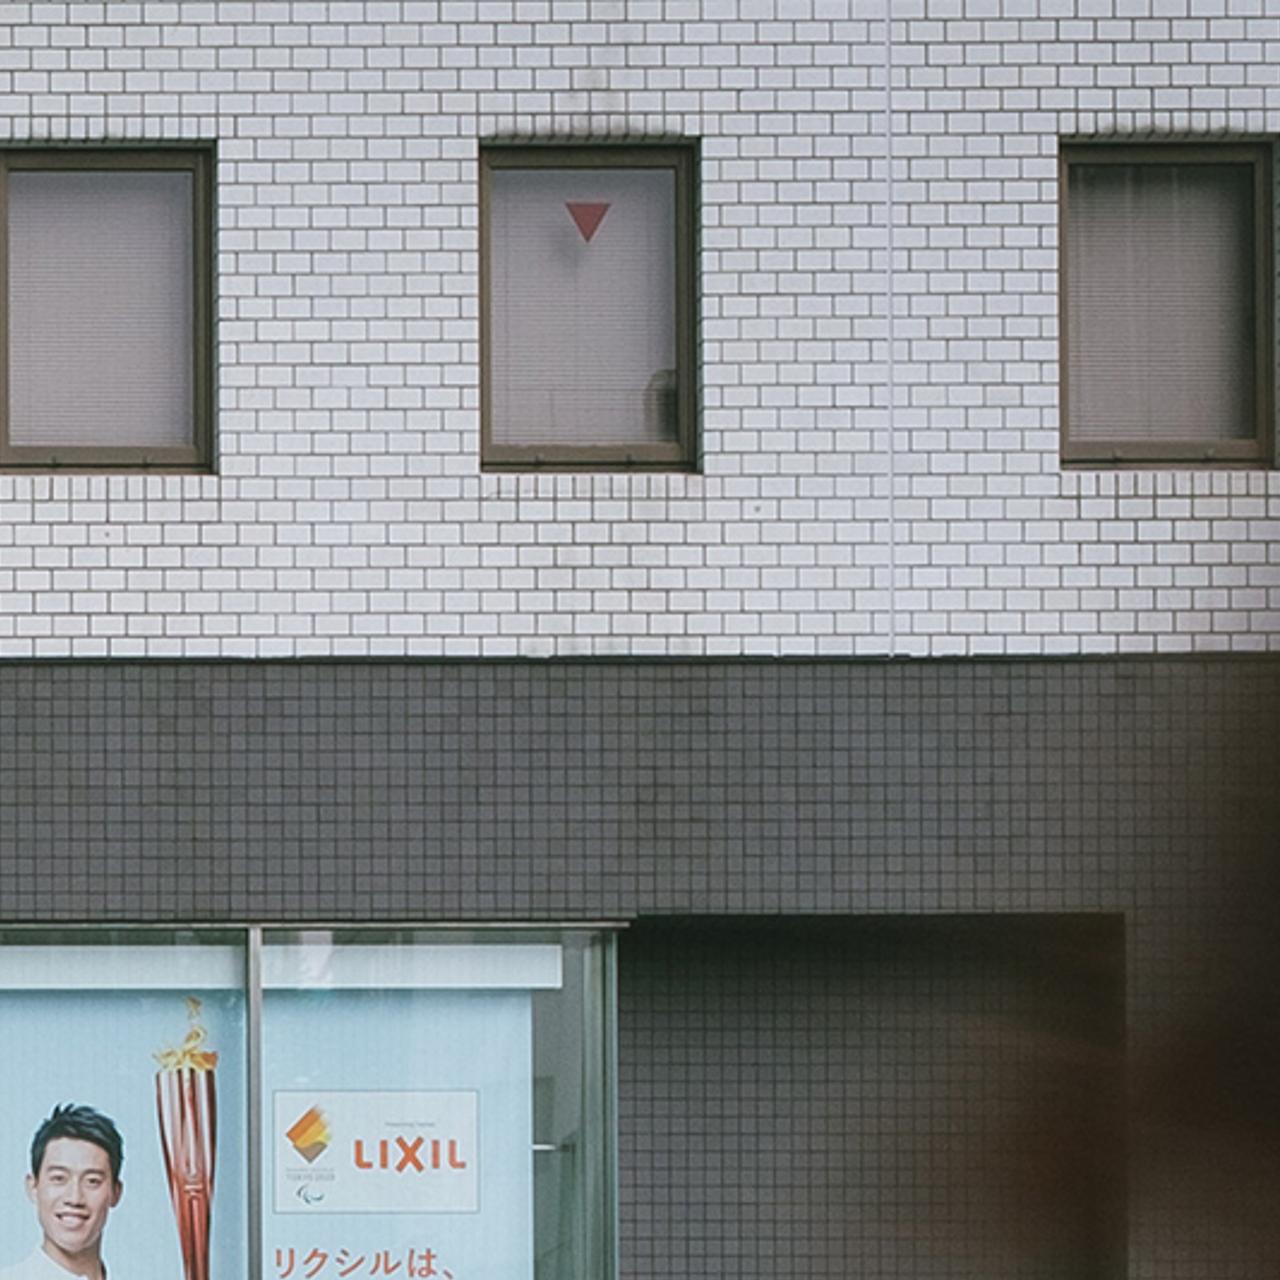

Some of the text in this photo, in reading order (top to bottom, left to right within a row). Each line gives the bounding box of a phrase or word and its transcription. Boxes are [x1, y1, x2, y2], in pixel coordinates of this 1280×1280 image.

[354, 1136, 466, 1173] LIXIL
[273, 1247, 454, 1280] リクシルは、
